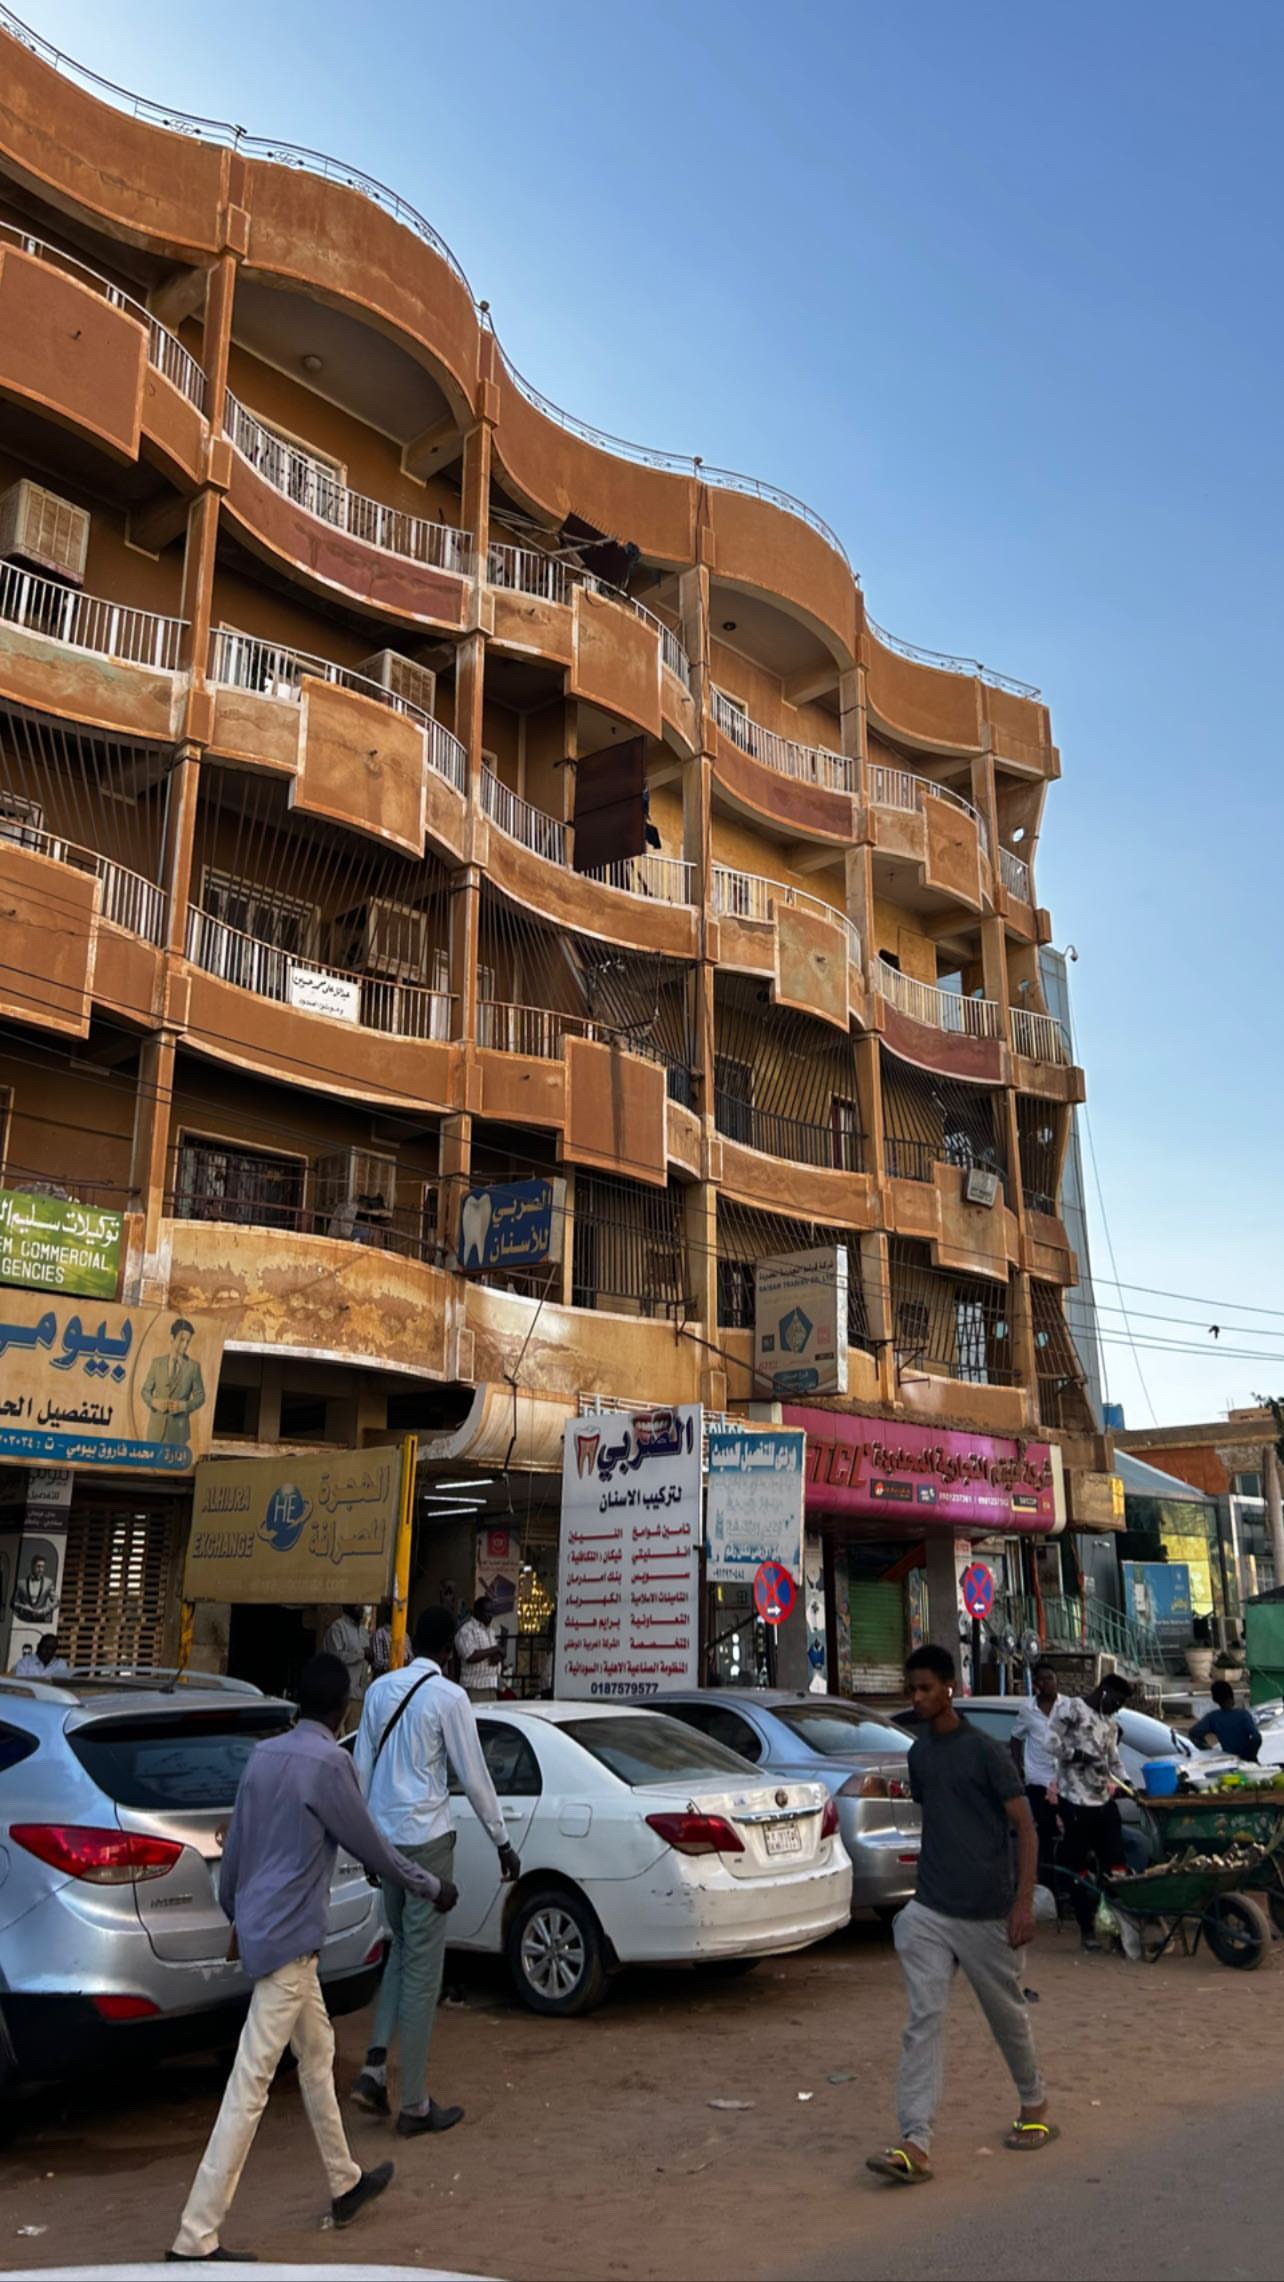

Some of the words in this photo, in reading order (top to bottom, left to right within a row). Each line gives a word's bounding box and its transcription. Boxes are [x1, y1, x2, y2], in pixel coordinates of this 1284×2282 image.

[61, 1211, 120, 1248] توكيلات
[20, 1240, 110, 1271] COMMERCIAL
[1, 1257, 65, 1284] GENCIES
[36, 1400, 114, 1428] للتفصيل
[66, 1445, 97, 1459] بيومي
[98, 1442, 128, 1459] فاروق
[129, 1447, 154, 1459] محمد
[935, 1446, 989, 1487] التجارية
[317, 1464, 391, 1514] الهجرة
[599, 1488, 640, 1514] الاسنان
[643, 1485, 682, 1510] لتركيب
[274, 1494, 298, 1524] HE
[192, 1531, 255, 1559] EXCHANGE
[308, 1518, 386, 1566] للصرافة
[607, 1570, 622, 1586] بنك
[566, 1592, 622, 1608] الكهرباء
[630, 1613, 690, 1629] التعاونية
[590, 1682, 659, 1695] 0187579577
